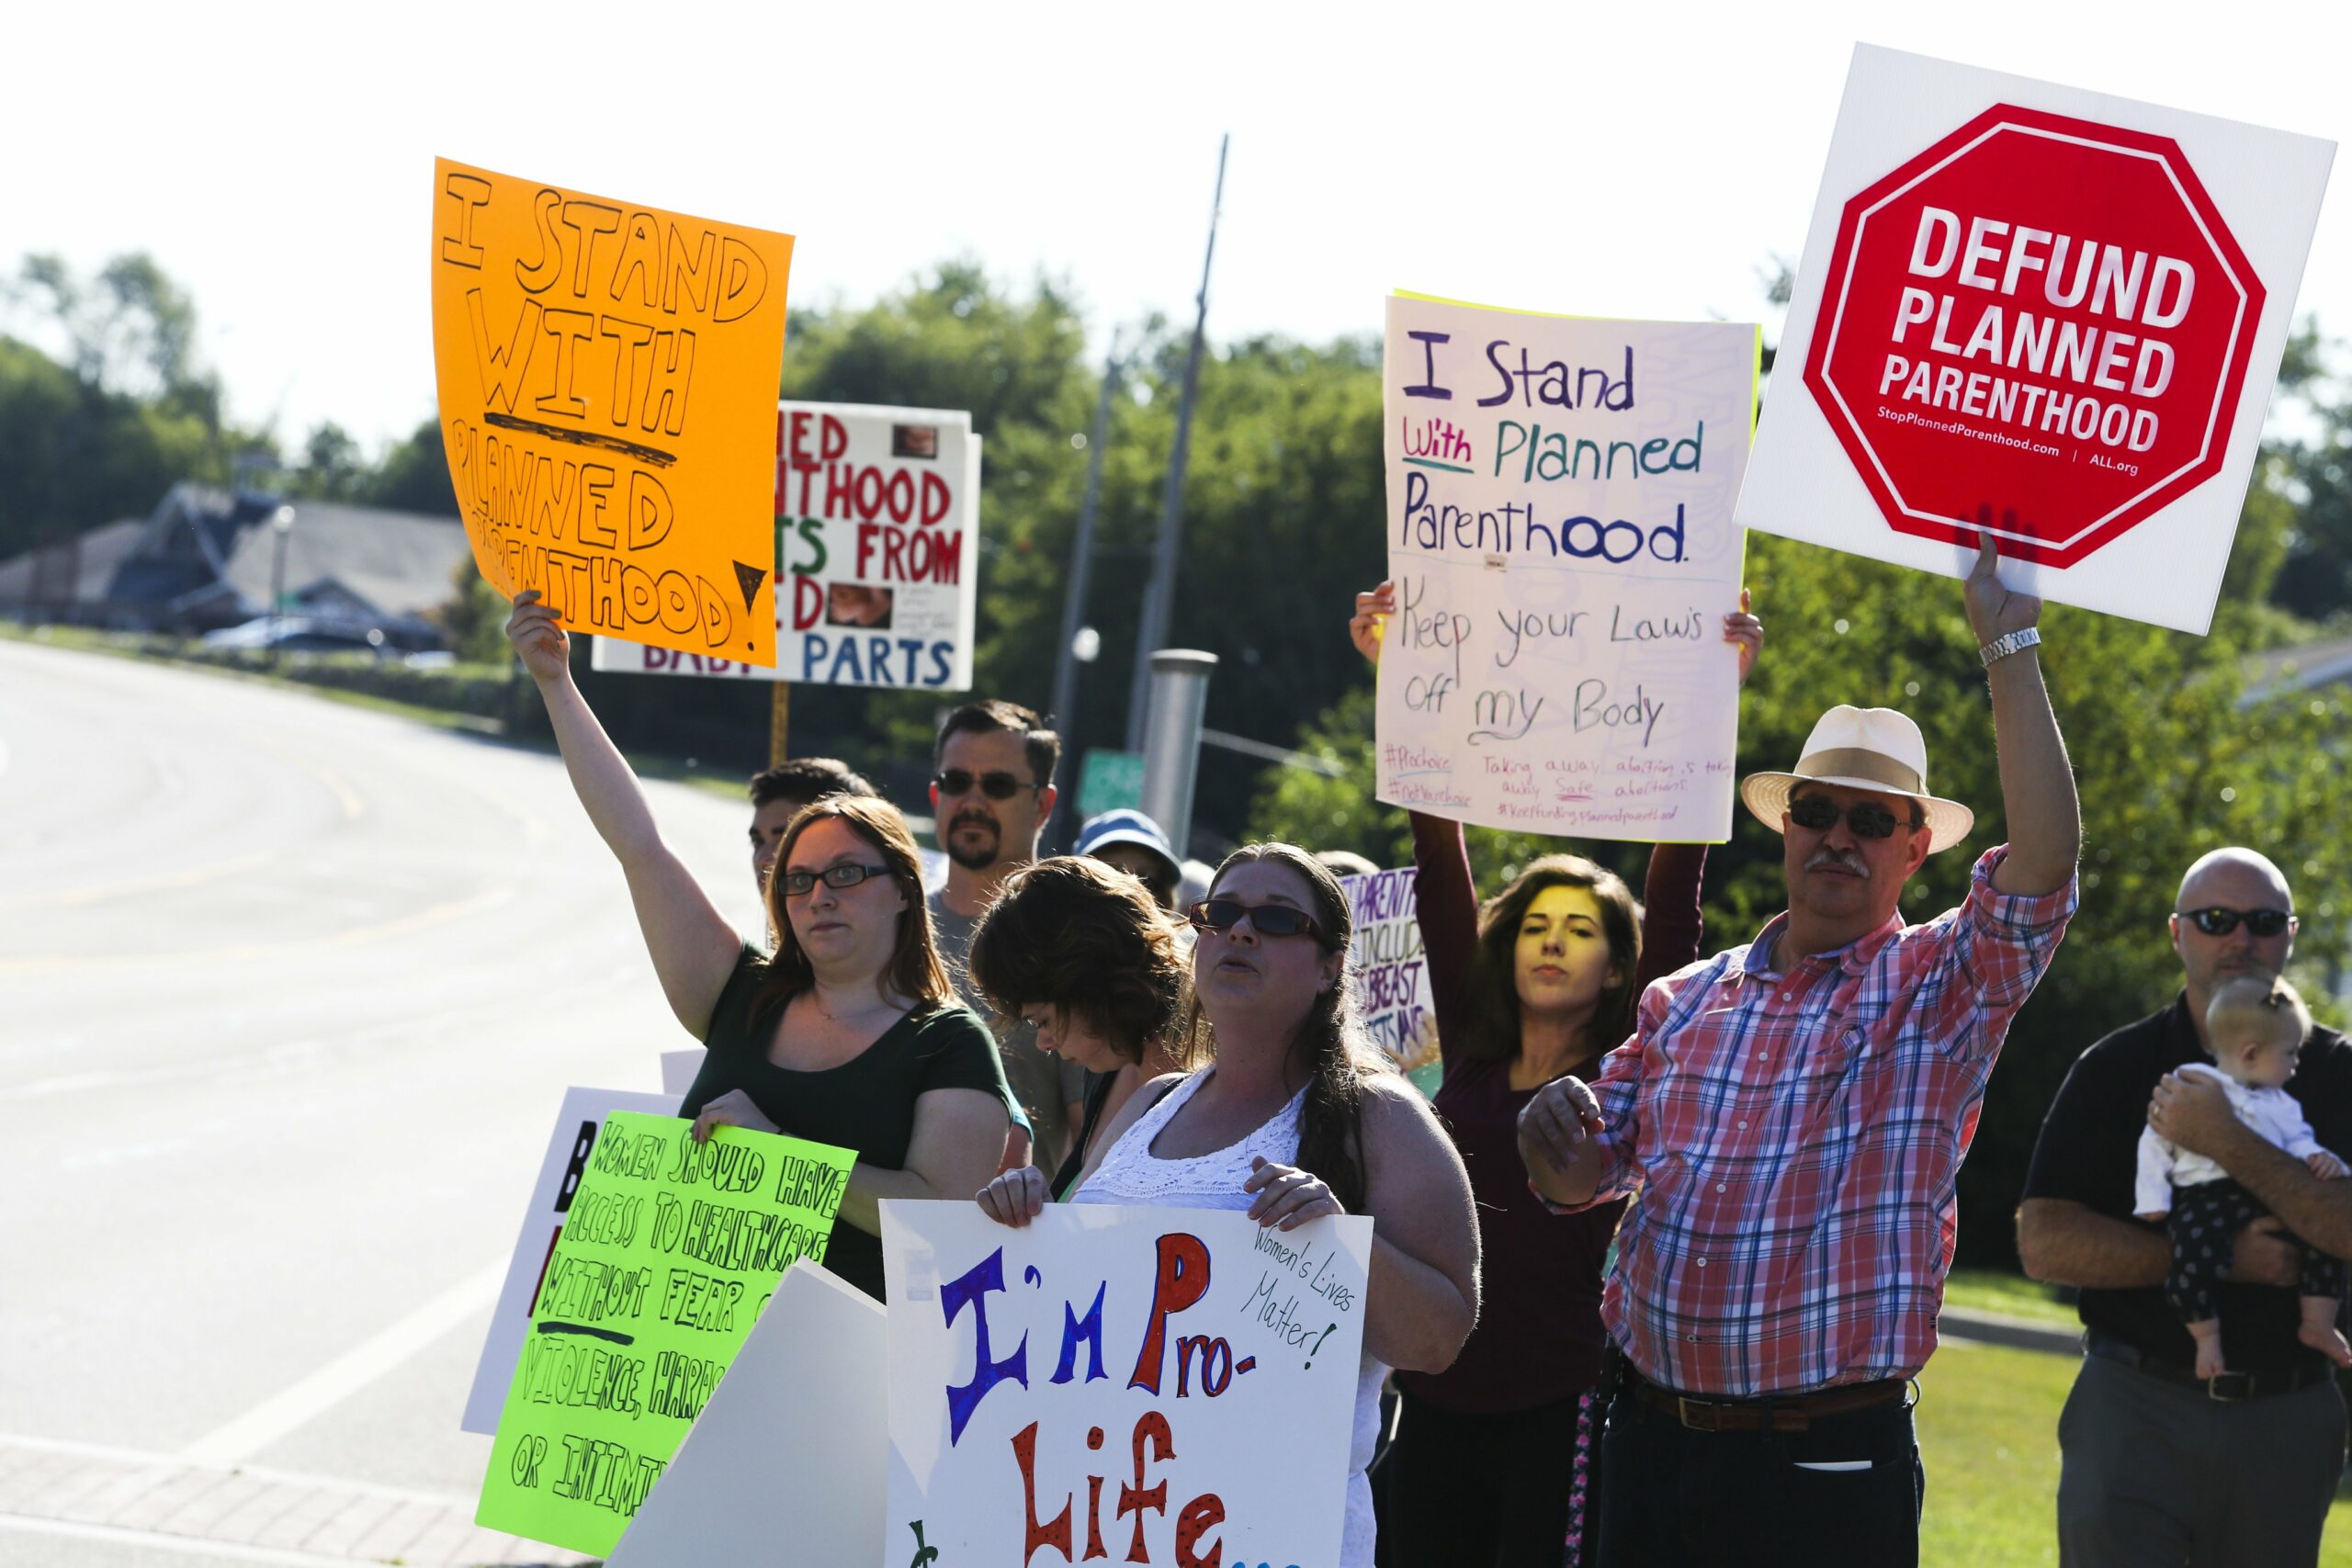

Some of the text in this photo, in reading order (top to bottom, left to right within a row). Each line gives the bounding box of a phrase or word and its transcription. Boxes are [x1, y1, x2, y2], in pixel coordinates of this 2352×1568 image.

[443, 173, 768, 323] I STAND
[1907, 205, 2196, 329] DEFUND
[467, 288, 695, 436] WITH
[1403, 331, 1634, 412] I Stand
[1891, 287, 2176, 399] PLANNED
[1877, 405, 2139, 477] StopPlannedParenthood.com ALL.org
[1878, 354, 2160, 453] PARENTHOOD
[452, 419, 674, 551] PLANNED
[1495, 421, 1703, 483] Planned
[856, 523, 962, 586] FROM
[1403, 471, 1690, 564] Parenthood.
[802, 634, 955, 687] PARTS
[1402, 576, 1472, 689] Keep
[1496, 609, 1589, 668] your
[1574, 679, 1665, 749] Body
[1360, 919, 1426, 969] INCLUD
[594, 1122, 850, 1220] WOMEN SHOULD HAVE
[564, 1184, 831, 1272] ACCESS TO HEALTHCARE
[1255, 1224, 1355, 1312] Women's Lives
[541, 1251, 651, 1321] WITHOUT
[660, 1269, 745, 1332] FEAR
[1126, 1233, 1256, 1397] Pro-
[1240, 1270, 1338, 1371] Matter!
[523, 1337, 645, 1421] VIOLENCE,
[512, 1434, 668, 1517] OR INTIMI
